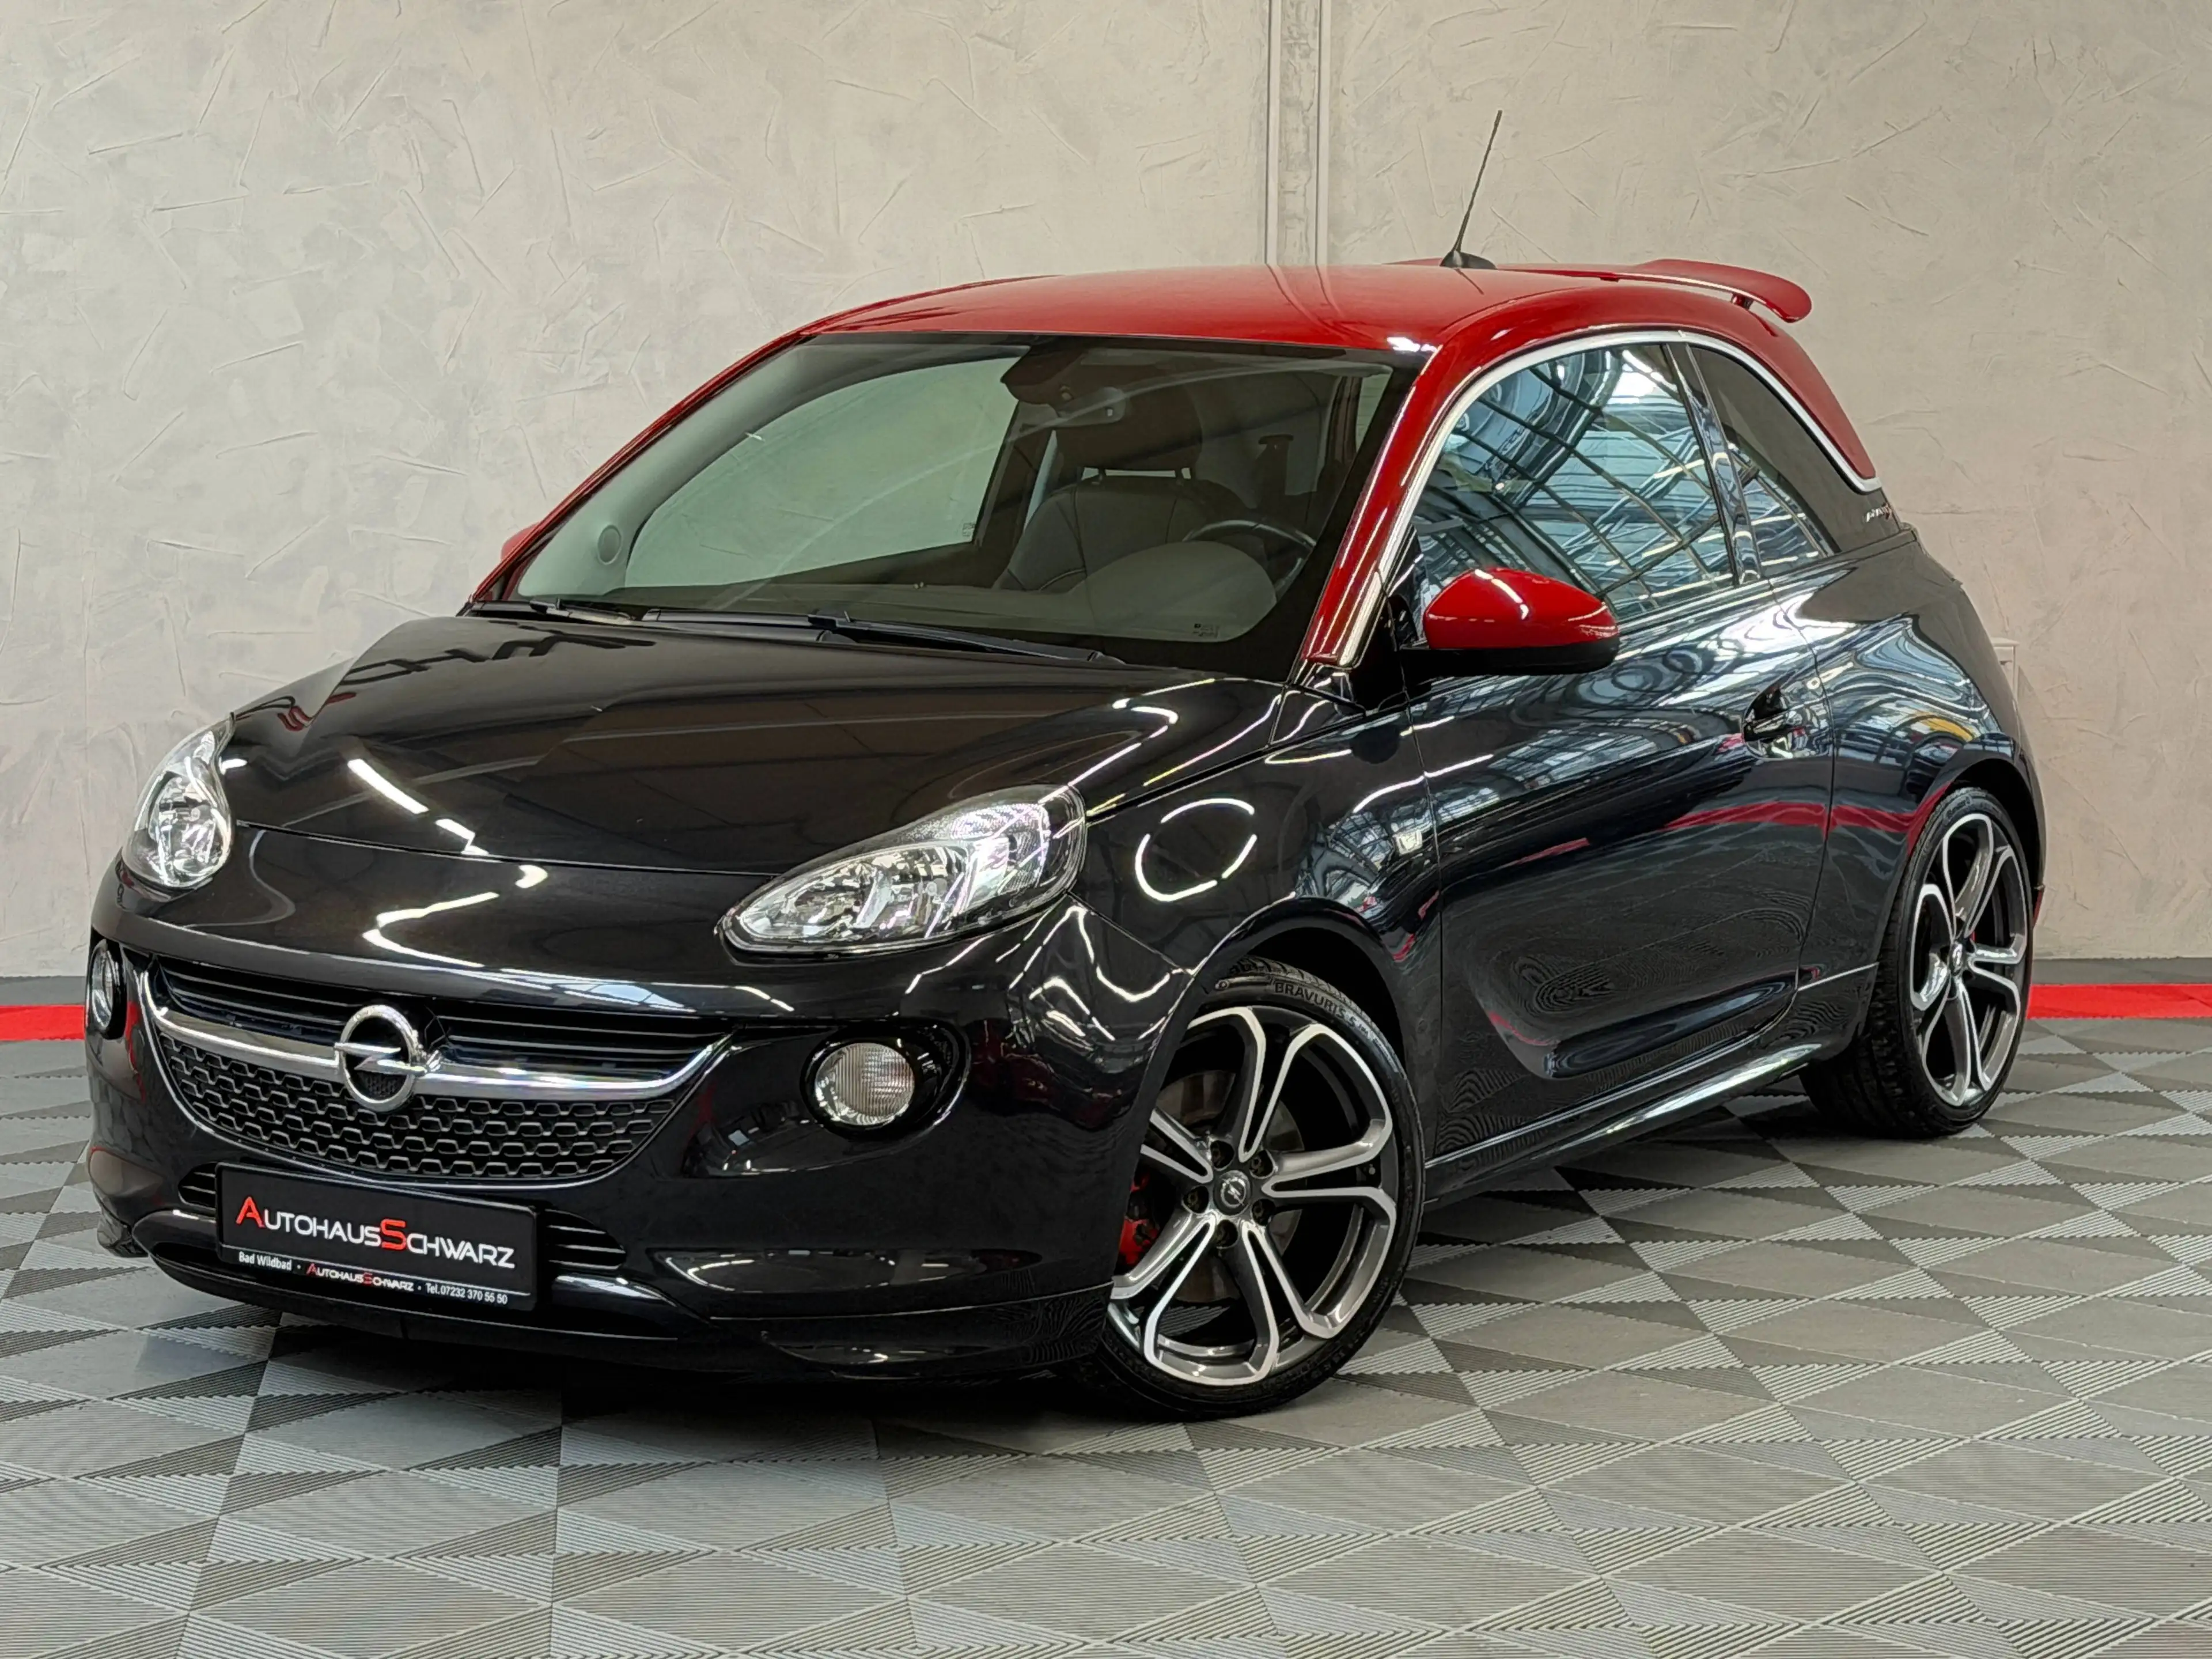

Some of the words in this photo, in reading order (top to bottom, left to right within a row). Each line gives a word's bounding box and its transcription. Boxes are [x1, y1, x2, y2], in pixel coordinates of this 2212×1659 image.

[1275, 982, 1346, 1019] BRAVURIS
[238, 1251, 255, 1264] Bad
[256, 1254, 293, 1271] Wildbad
[467, 1289, 483, 1301] 370
[484, 1291, 495, 1304] 55
